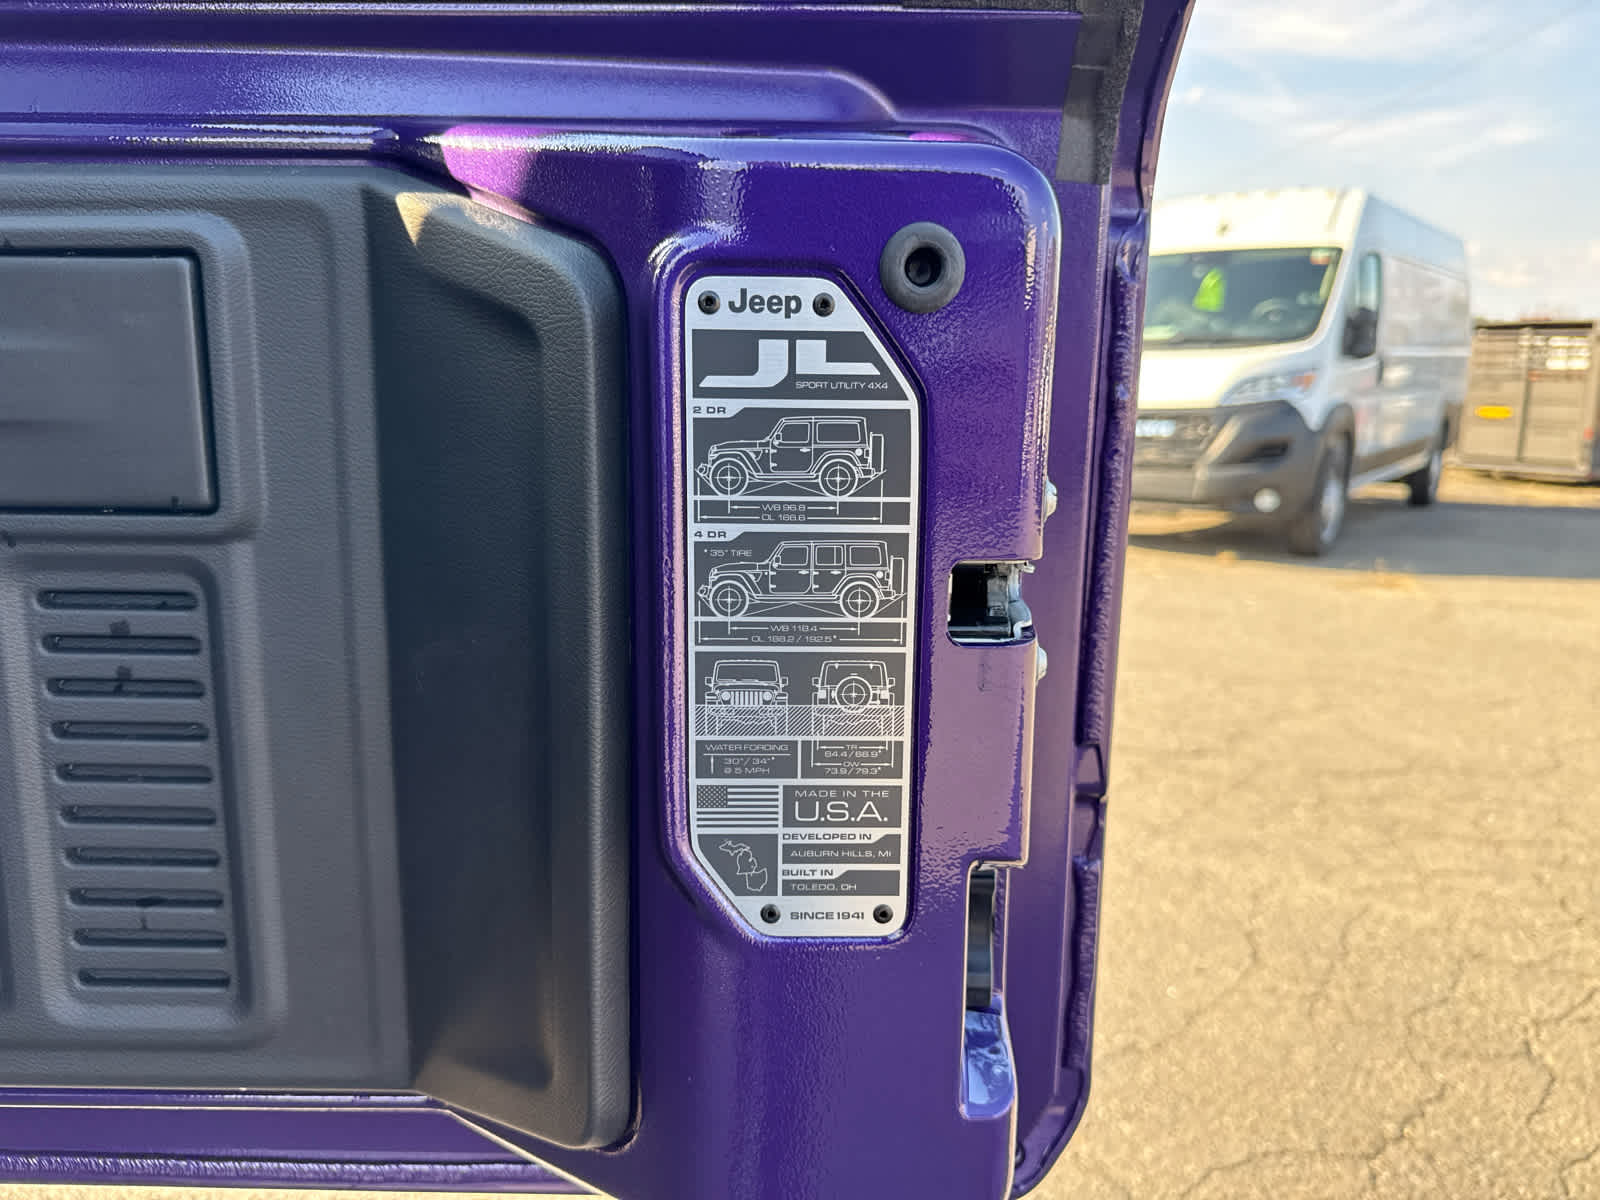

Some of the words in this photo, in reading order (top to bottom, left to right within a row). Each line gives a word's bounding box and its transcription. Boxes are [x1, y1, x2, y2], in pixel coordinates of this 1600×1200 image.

[728, 288, 802, 319] Jeep
[699, 339, 881, 388] JL
[795, 381, 828, 390] SPORT
[830, 381, 866, 390] UTILITY
[867, 381, 888, 390] 4X4
[693, 407, 702, 415] 2
[706, 407, 727, 415] DR
[761, 503, 781, 512] WB
[761, 513, 775, 521] OL
[730, 549, 753, 557] TIRE
[770, 624, 790, 632] WB
[751, 635, 768, 643] OL
[744, 767, 770, 775] MPH
[794, 790, 839, 798] MADE
[842, 790, 857, 798] IN
[862, 790, 889, 798] THE
[794, 801, 889, 822] U.S.A.
[841, 850, 876, 858] HILLS,
[790, 911, 835, 920] SINCE
[836, 911, 865, 920] 1941
